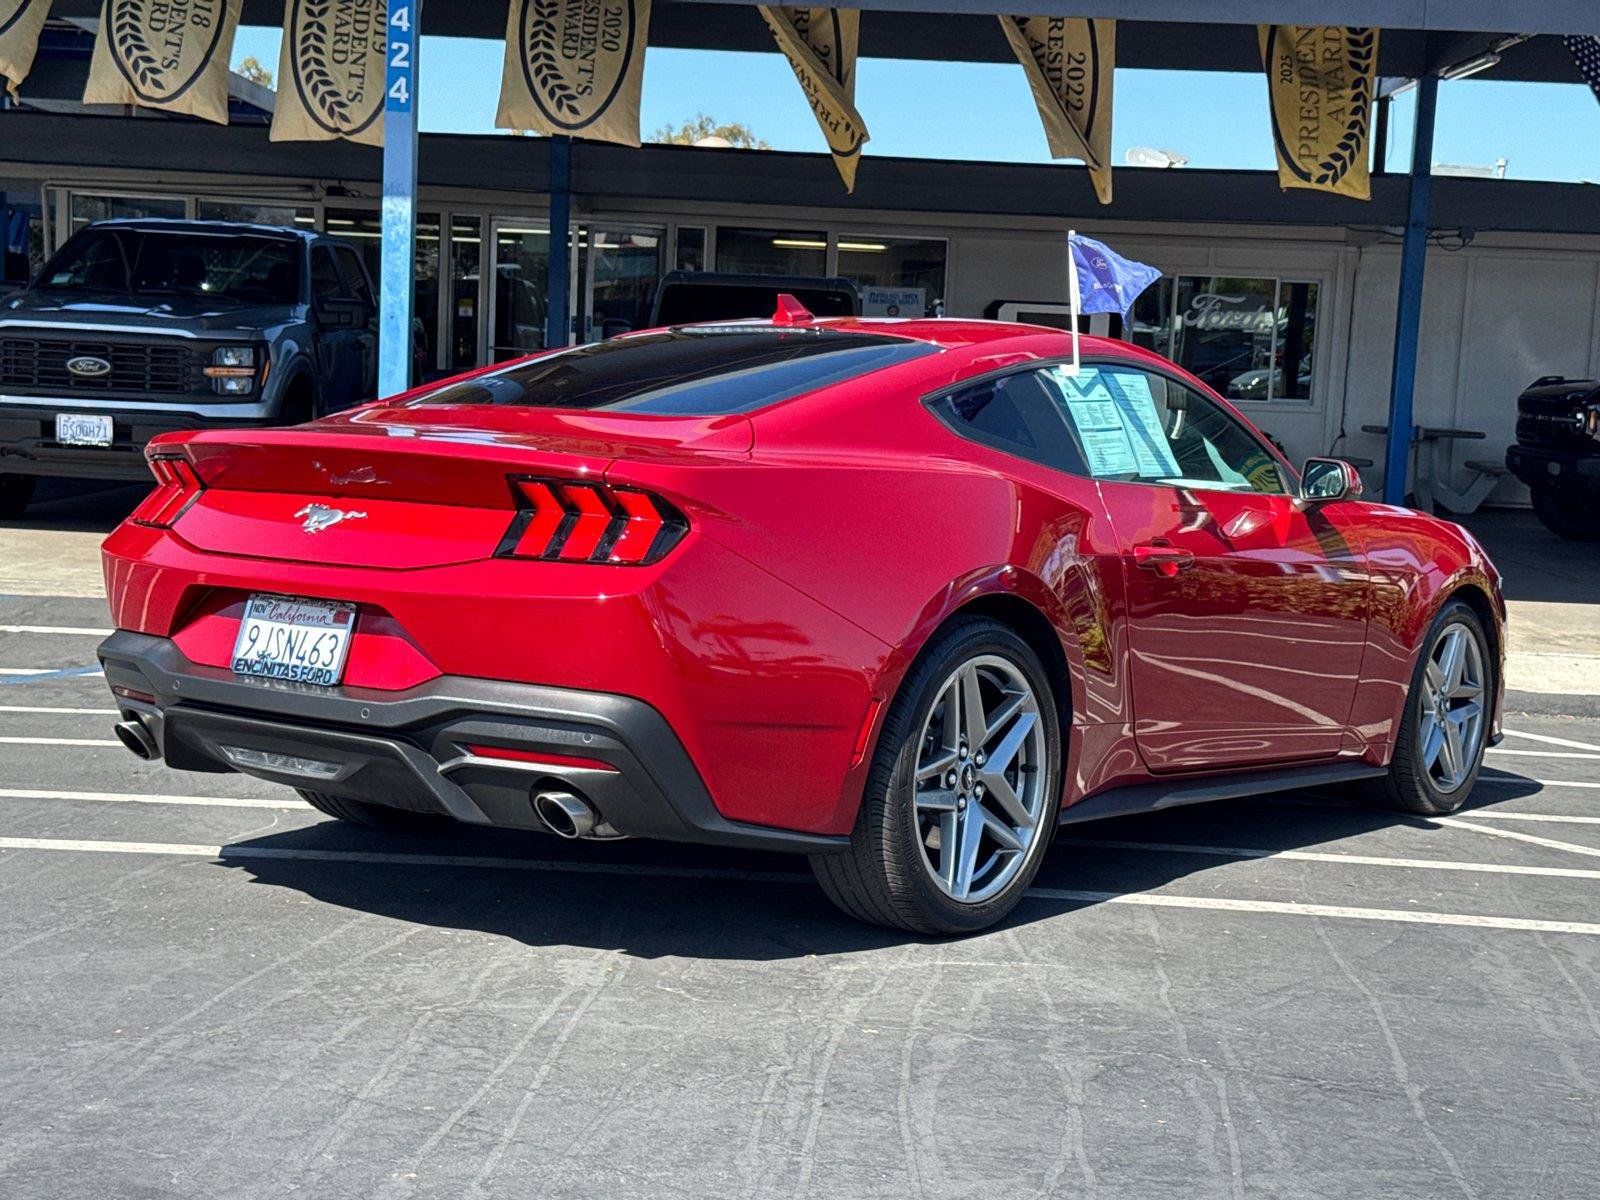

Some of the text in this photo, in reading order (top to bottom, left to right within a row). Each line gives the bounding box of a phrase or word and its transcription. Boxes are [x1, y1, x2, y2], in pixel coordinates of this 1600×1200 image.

[602, 7, 623, 52] 2020
[388, 6, 410, 104] 424
[1281, 55, 1293, 84] 2025
[1064, 52, 1086, 112] 2022
[1323, 26, 1346, 127] AWARD
[1183, 293, 1266, 331] Ford
[77, 360, 100, 371] Ford
[253, 603, 267, 614] NOV
[268, 602, 331, 625] California
[243, 624, 338, 668] 9JSN463
[234, 658, 333, 684] ENCINITAS FORD
